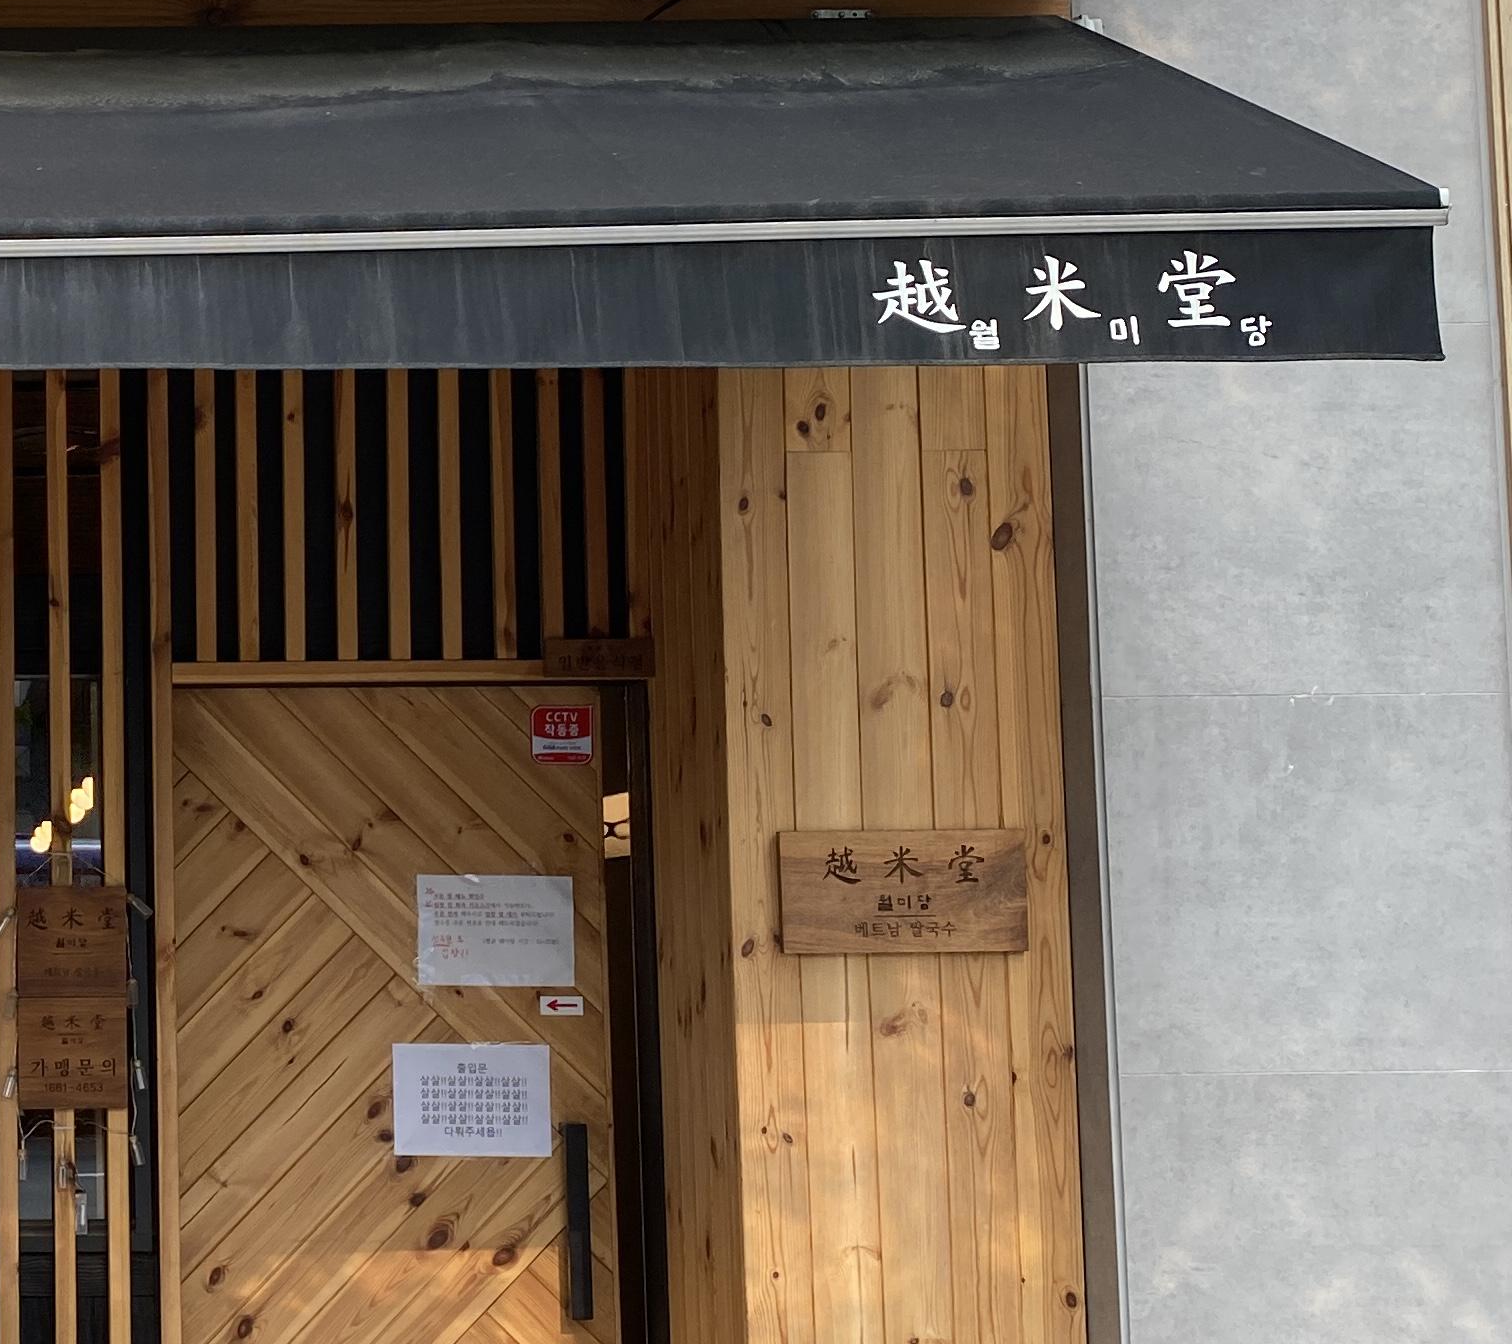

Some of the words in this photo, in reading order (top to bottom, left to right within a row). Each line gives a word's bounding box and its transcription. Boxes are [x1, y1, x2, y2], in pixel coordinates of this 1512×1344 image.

[545, 711, 579, 722] CCTV
[544, 723, 579, 736] 작동중
[877, 894, 932, 912] 월미당
[854, 921, 902, 938] 베트남
[910, 921, 958, 938] 쌀국수
[456, 1062, 489, 1075] 출입문
